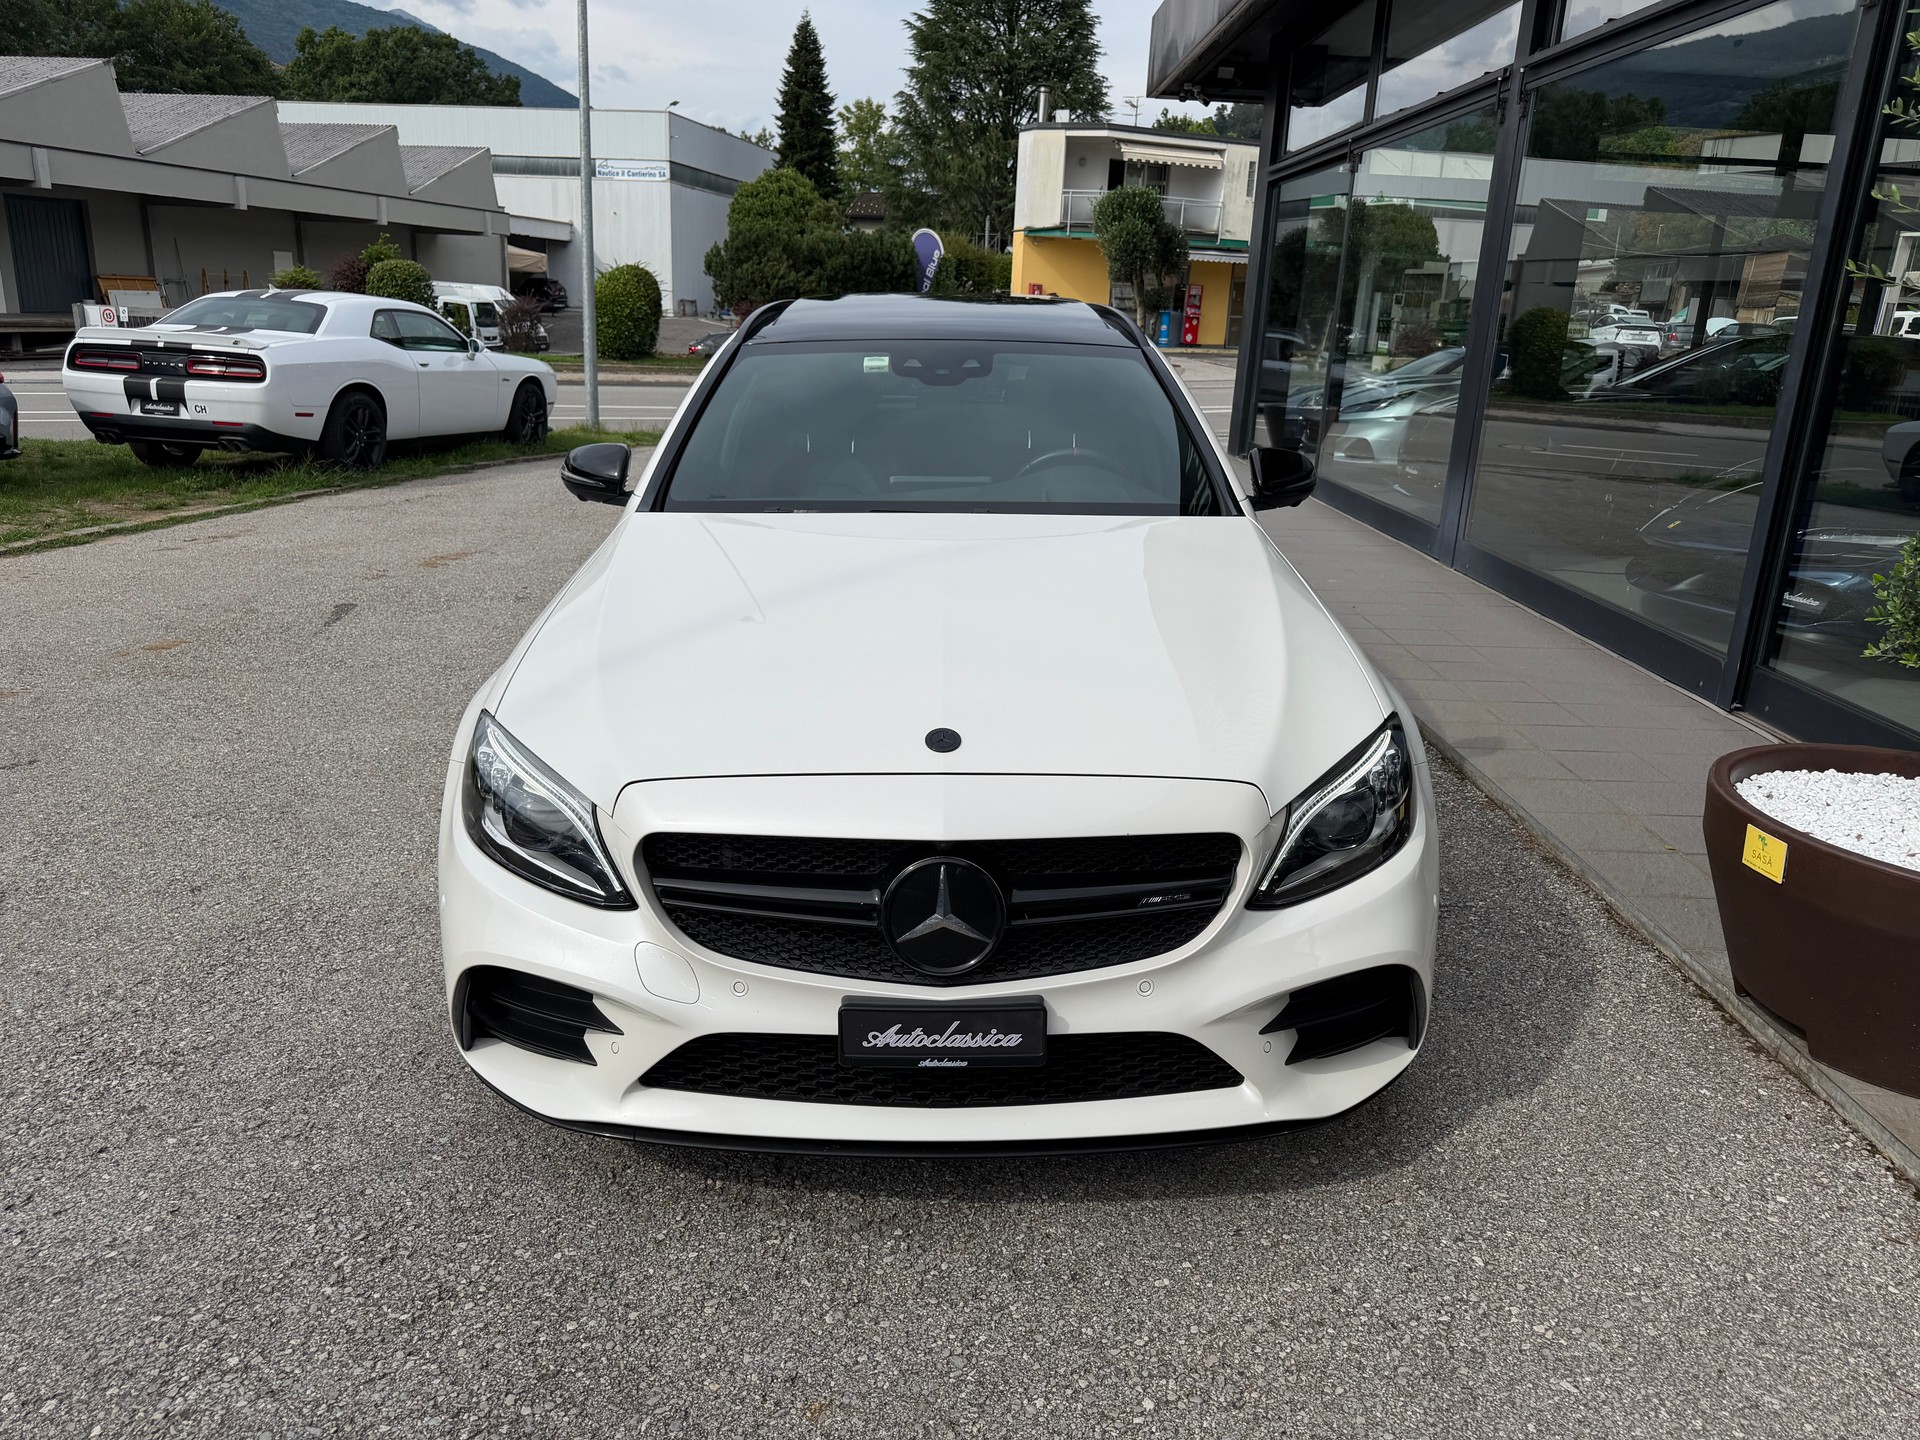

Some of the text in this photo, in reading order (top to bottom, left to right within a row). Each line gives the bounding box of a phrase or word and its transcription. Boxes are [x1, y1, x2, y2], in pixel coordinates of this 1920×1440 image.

[626, 170, 656, 178] Cantierino
[105, 312, 112, 320] 15
[194, 404, 208, 414] CH
[862, 1021, 1023, 1048] Autoclassica
